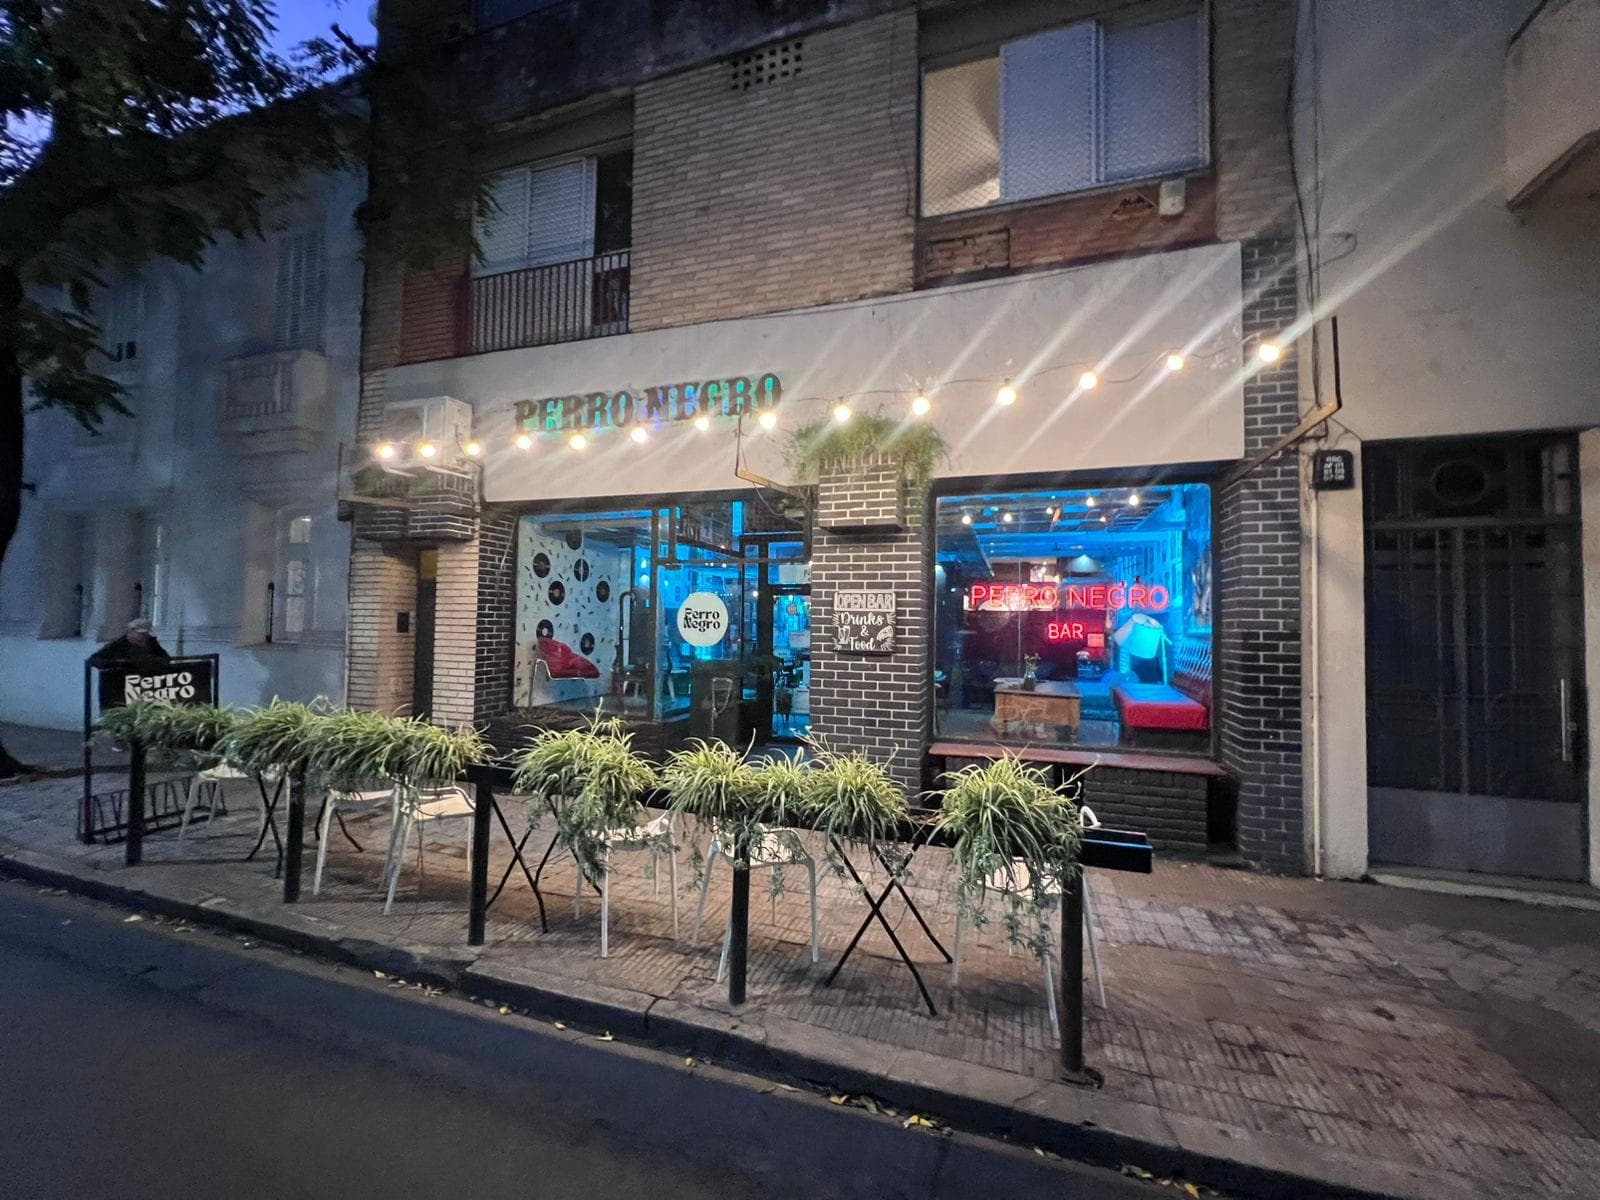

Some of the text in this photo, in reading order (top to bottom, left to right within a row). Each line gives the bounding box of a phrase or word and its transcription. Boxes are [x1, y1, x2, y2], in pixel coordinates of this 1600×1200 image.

[513, 372, 783, 430] PERRO NEGRO
[836, 593, 893, 610] OPEN BAR
[971, 584, 1169, 611] PERRO NEGRO
[684, 607, 720, 620] Perro
[841, 611, 885, 626] Drinks
[683, 616, 721, 632] Negro
[860, 624, 870, 637] &
[1047, 622, 1084, 640] BAR
[125, 671, 193, 690] Perro
[125, 685, 195, 706] Negro
